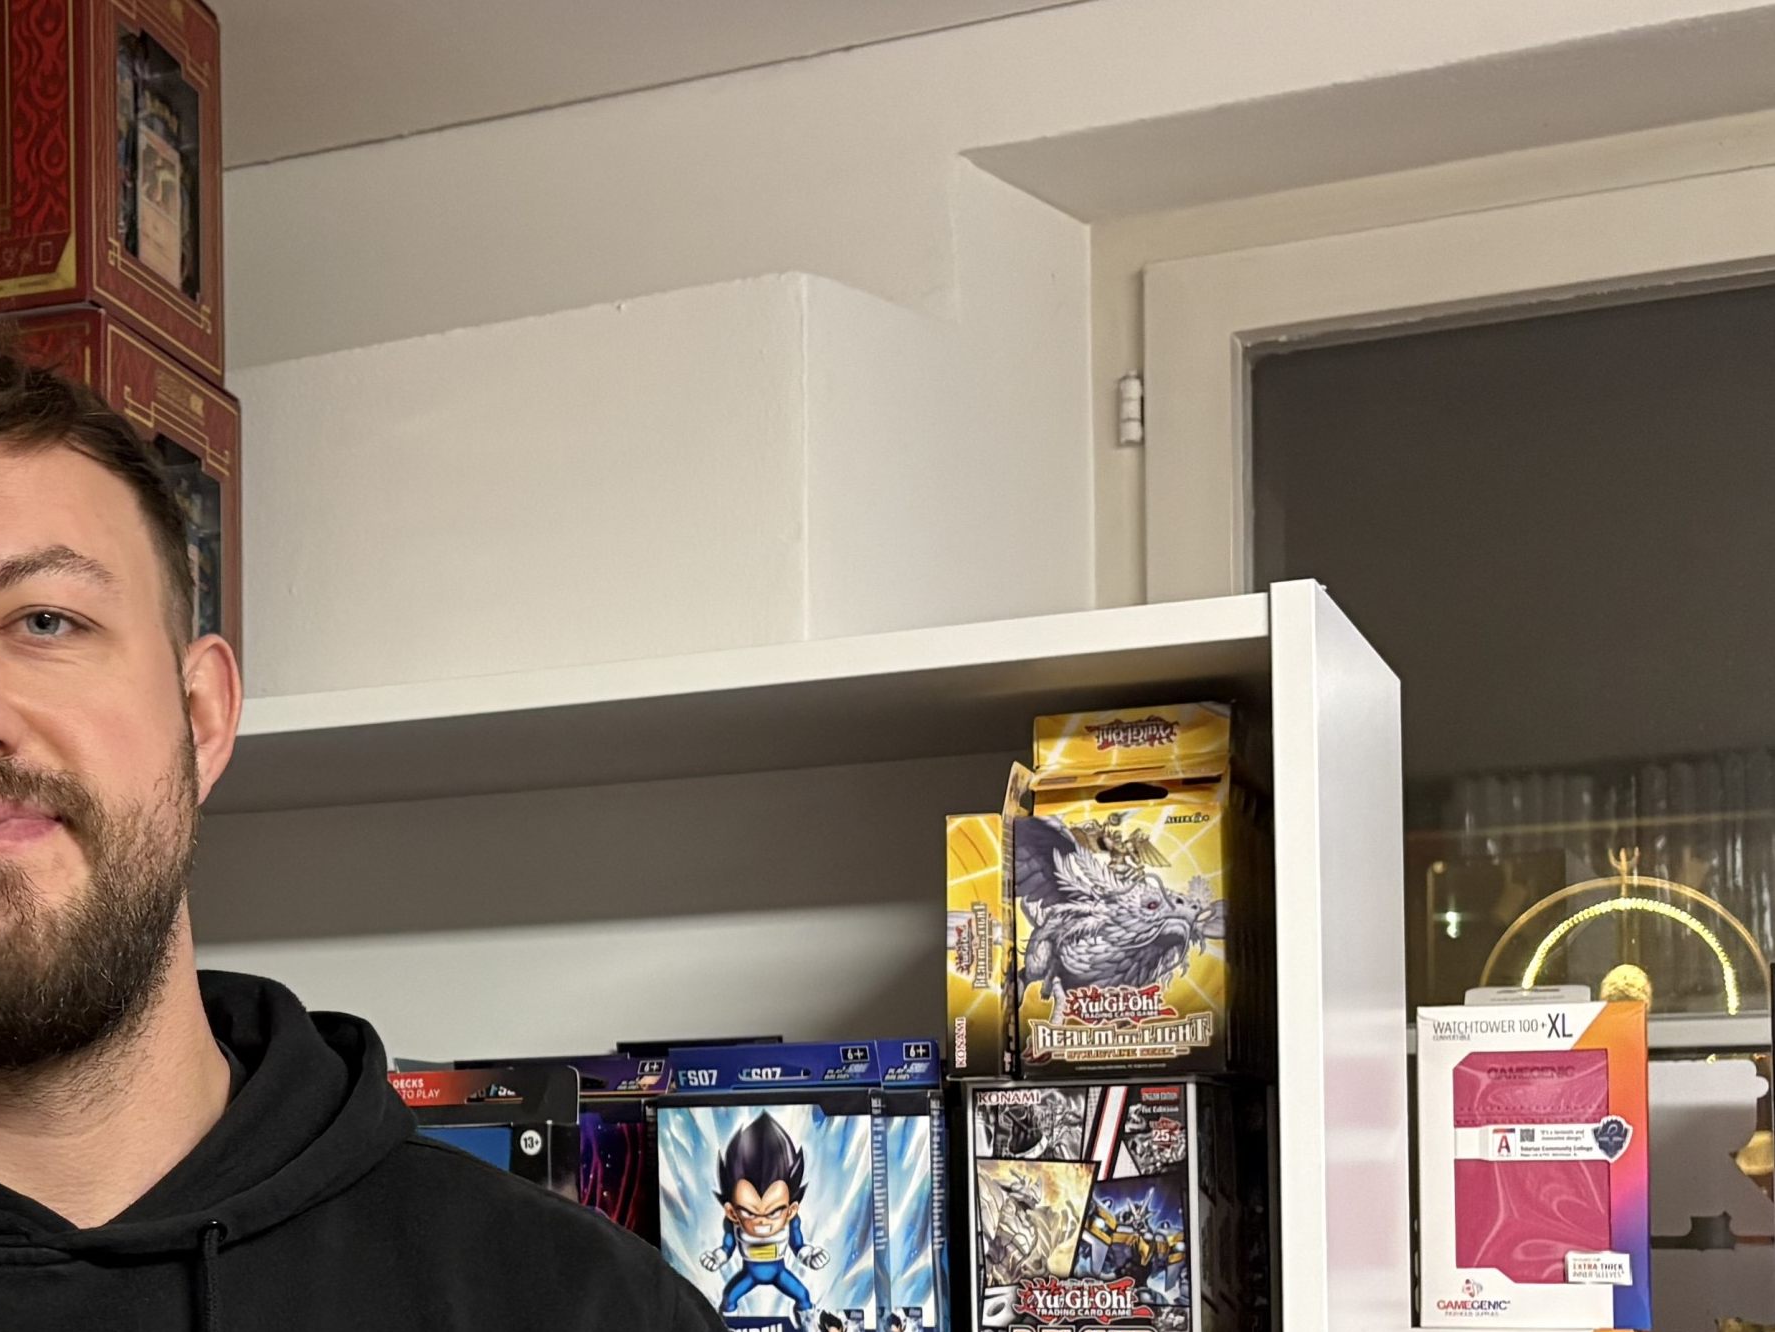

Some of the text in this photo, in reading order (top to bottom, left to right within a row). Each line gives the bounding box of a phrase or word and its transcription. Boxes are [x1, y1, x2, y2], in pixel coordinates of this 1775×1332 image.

[1081, 1009, 1160, 1020] TRADING CARD GAME
[1433, 1020, 1515, 1035] WATCHTOWER
[1547, 1012, 1573, 1039] XL
[1036, 1018, 1211, 1048] REALM LIGHT
[955, 1017, 967, 1068] KONAMI
[846, 1048, 864, 1061] 6+
[909, 1043, 927, 1057] 6+
[644, 1061, 660, 1073] 6+
[1487, 1066, 1576, 1081] GAMEGENIC
[394, 1078, 424, 1089] DECKS
[678, 1069, 719, 1087] FS07
[416, 1089, 441, 1099] PLAY
[977, 1091, 1042, 1105] KONAMI
[1153, 1130, 1170, 1142] 25
[522, 1136, 541, 1150] 13+
[1497, 1134, 1511, 1154] A
[1573, 1263, 1624, 1271] EXTRA THICK
[1437, 1300, 1507, 1311] GAMEGENIC
[1036, 1308, 1132, 1317] TRADING CARD GAME
